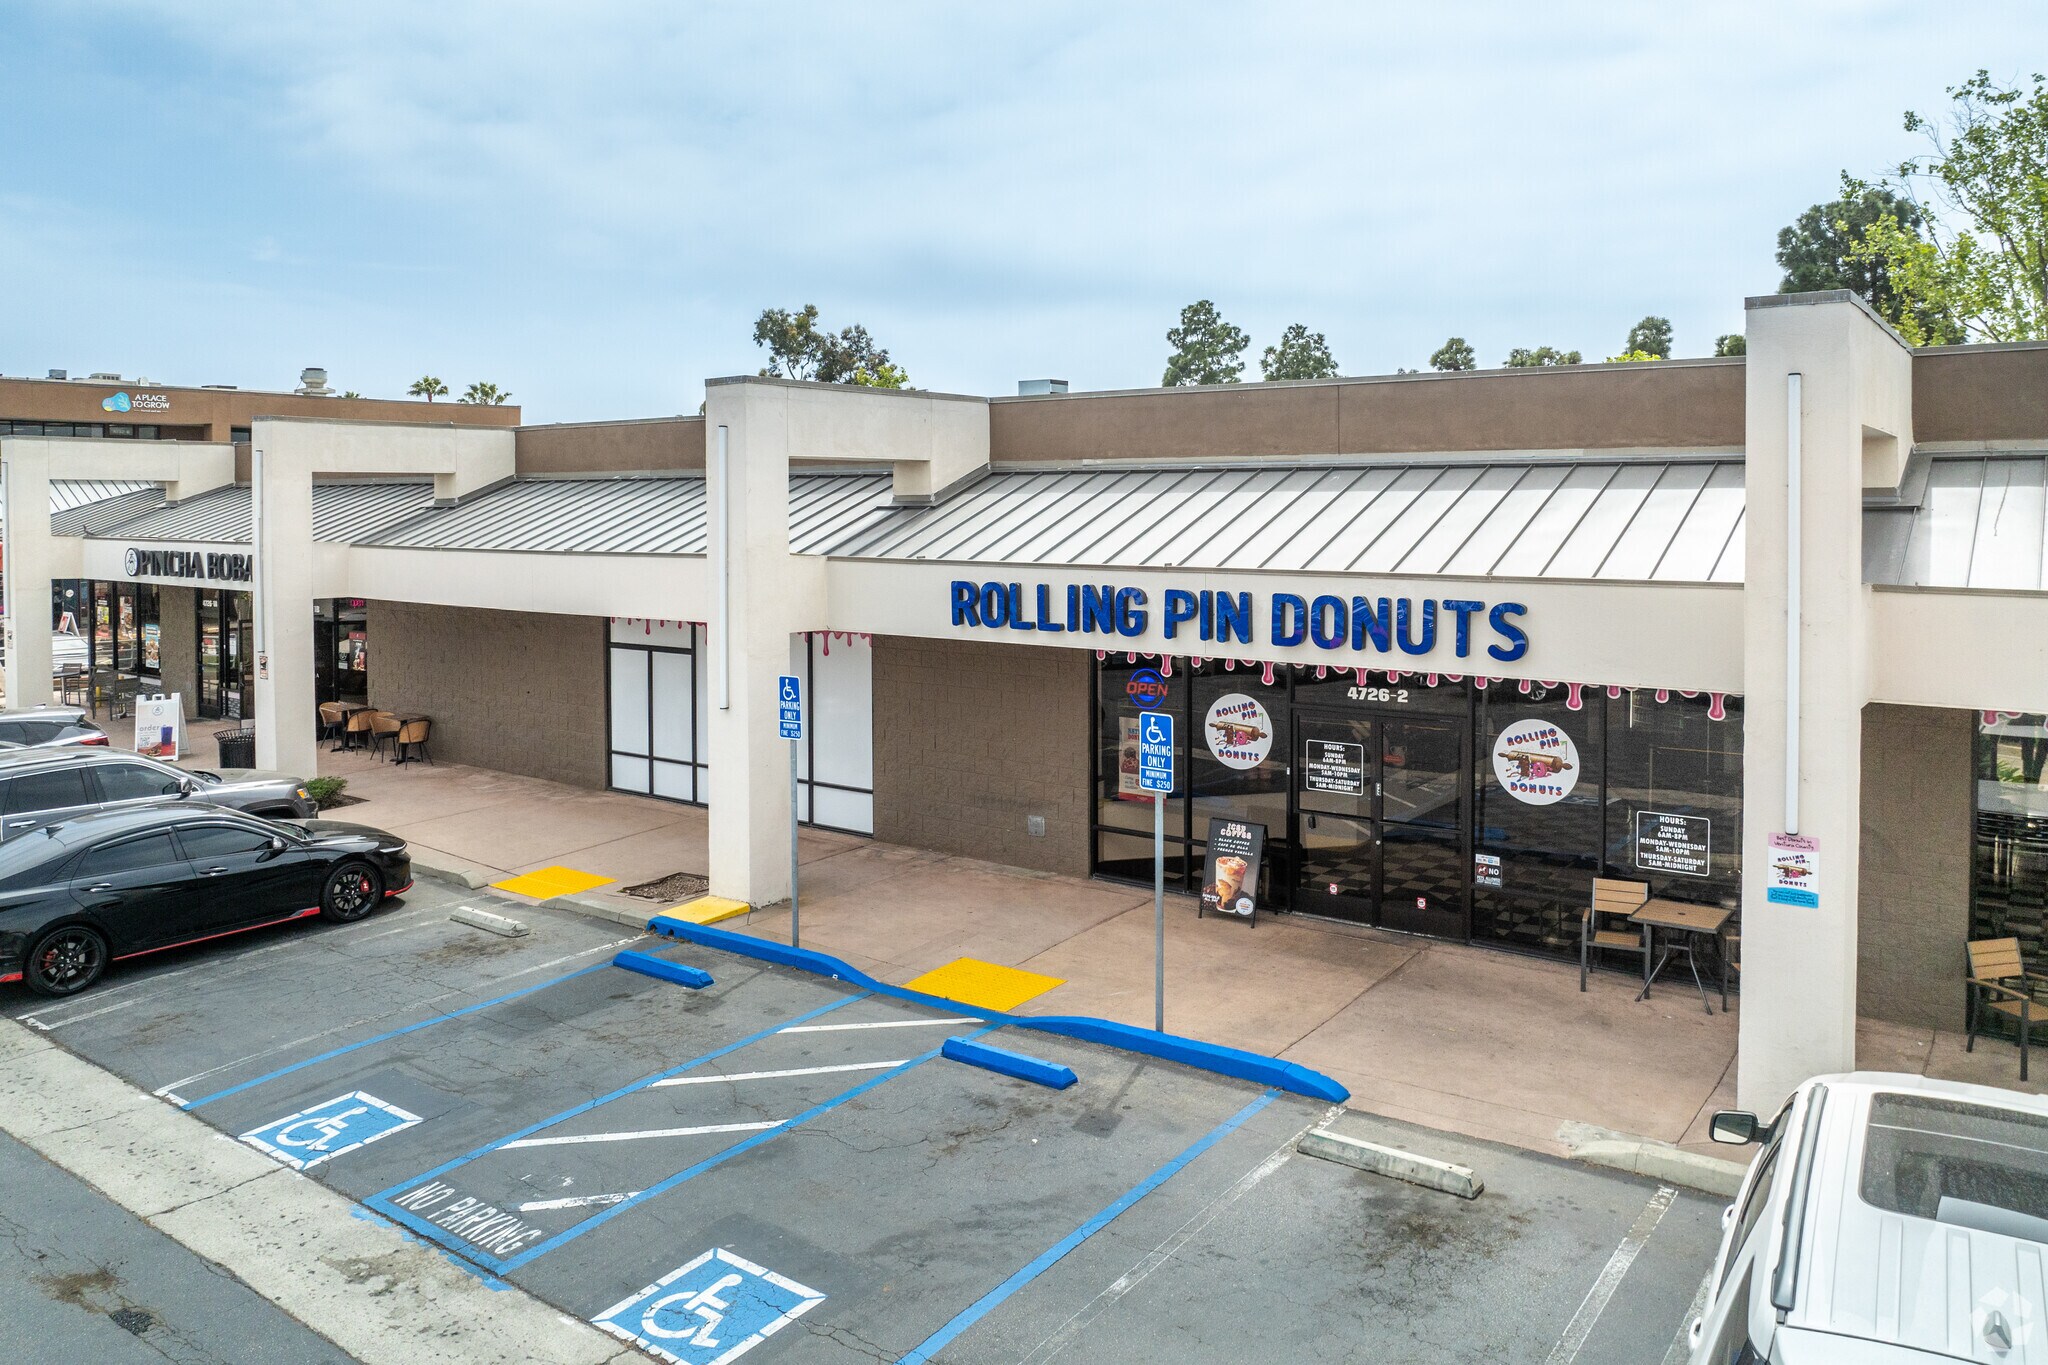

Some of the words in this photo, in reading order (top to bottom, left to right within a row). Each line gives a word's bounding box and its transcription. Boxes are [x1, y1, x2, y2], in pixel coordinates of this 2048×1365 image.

[142, 394, 166, 402] PLACE
[140, 550, 204, 578] PINCHA
[950, 580, 1148, 637] ROLLING
[1164, 589, 1254, 645] PIN
[1271, 593, 1529, 662] DONUTS
[1126, 681, 1168, 697] OPEN
[1347, 686, 1409, 703] 4726-2
[781, 701, 800, 710] PARKING
[1216, 701, 1256, 717] ROLLING
[784, 711, 796, 720] ONLY
[1242, 710, 1258, 720] PIN
[1507, 728, 1557, 746] ROLLING
[1540, 737, 1560, 749] PIN
[1142, 743, 1171, 757] PARKING
[1219, 749, 1260, 761] DONUTS
[1148, 756, 1166, 768] ONLY
[1146, 770, 1167, 780] MINIMUM
[1142, 778, 1153, 787] FINE
[1156, 780, 1171, 790] $250
[1510, 782, 1562, 796] DONUTS
[1660, 816, 1686, 825] HOURS:
[1227, 823, 1246, 831] ICED
[1220, 828, 1252, 839] COFFEE
[1658, 832, 1688, 840] 6AM-8PM
[1640, 838, 1706, 851] MONDAY-WEDNESDAY
[1656, 846, 1690, 855] 5AM-10PM
[1641, 852, 1705, 866] THURSDAY-SATURDAY
[1649, 860, 1697, 871] 5AM-MIDNIGHT
[394, 1181, 455, 1211] NO
[426, 1196, 542, 1254] PARKING
